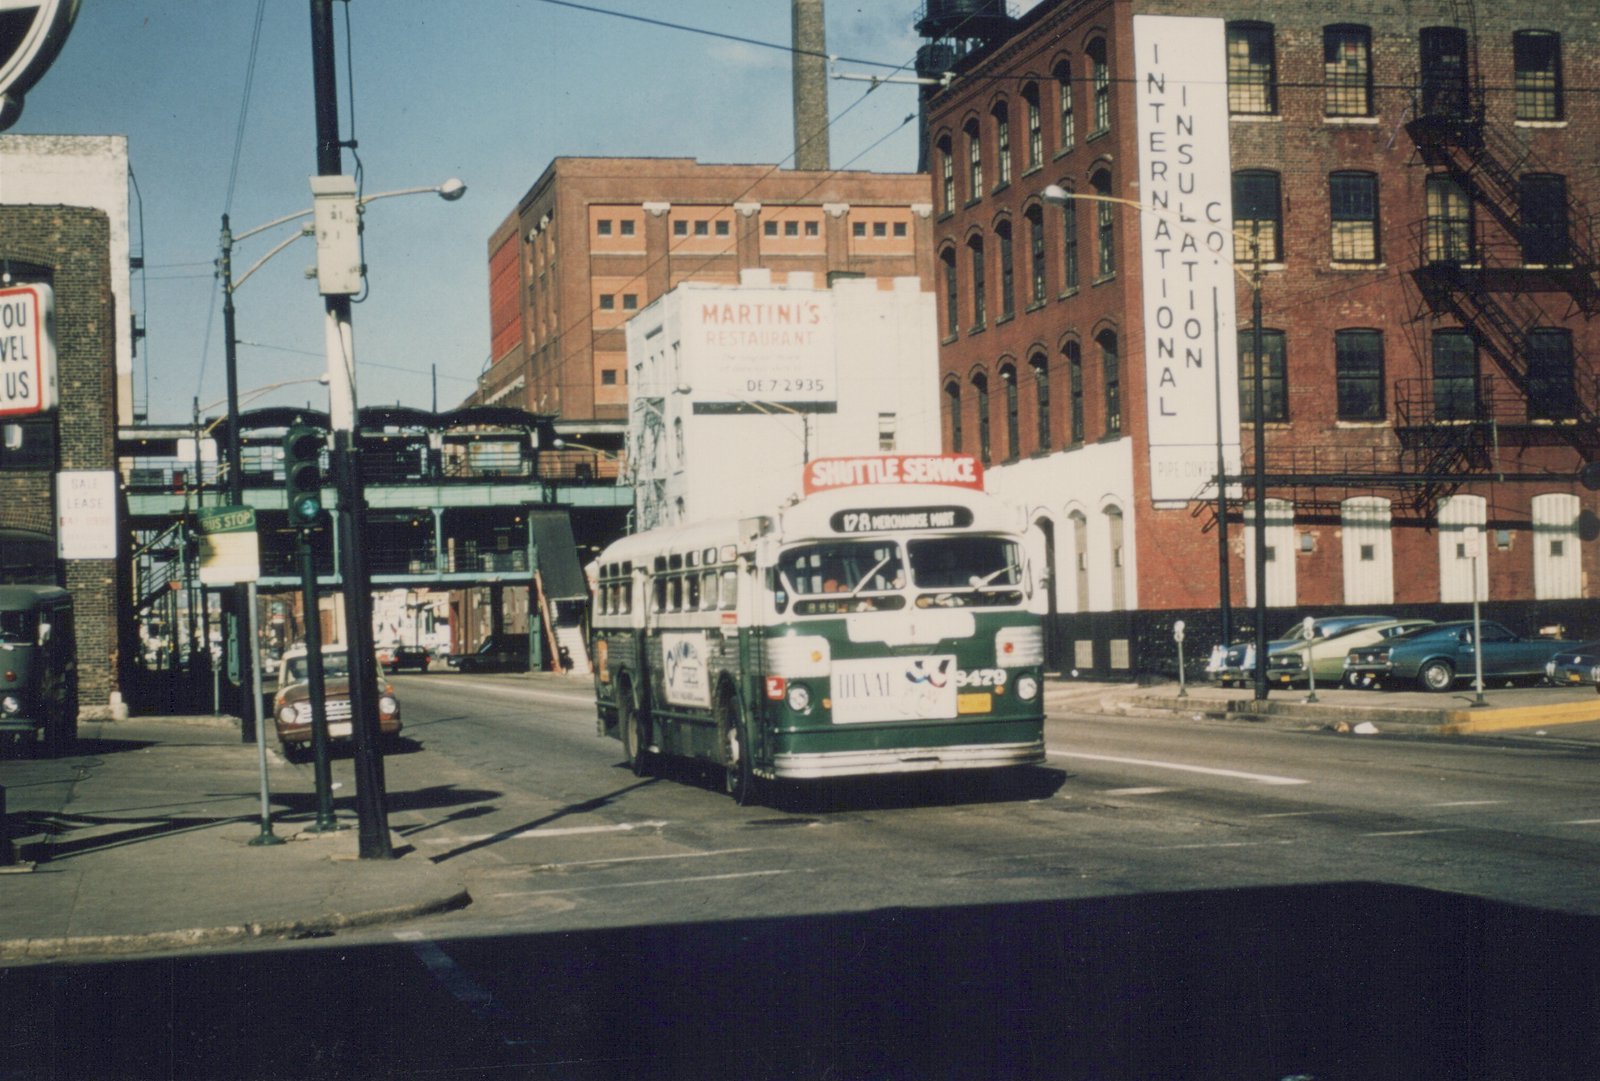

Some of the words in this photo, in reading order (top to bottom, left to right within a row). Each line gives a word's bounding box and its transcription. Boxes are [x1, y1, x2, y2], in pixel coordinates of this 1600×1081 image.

[1147, 43, 1177, 417] INTERNATIONAL
[1176, 85, 1202, 369] INSULATION
[1205, 201, 1225, 265] CO.
[0, 302, 27, 329] OU
[702, 301, 821, 325] MARTINI'S
[705, 331, 815, 347] RESTAURANT
[6, 370, 29, 400] US
[784, 379, 824, 392] 2935
[811, 458, 900, 486] SHUTTLE
[903, 457, 976, 483] SERVICE
[67, 498, 104, 510] LEASE
[202, 516, 222, 531] BUS
[224, 511, 251, 528] STOP
[930, 511, 954, 527] MART
